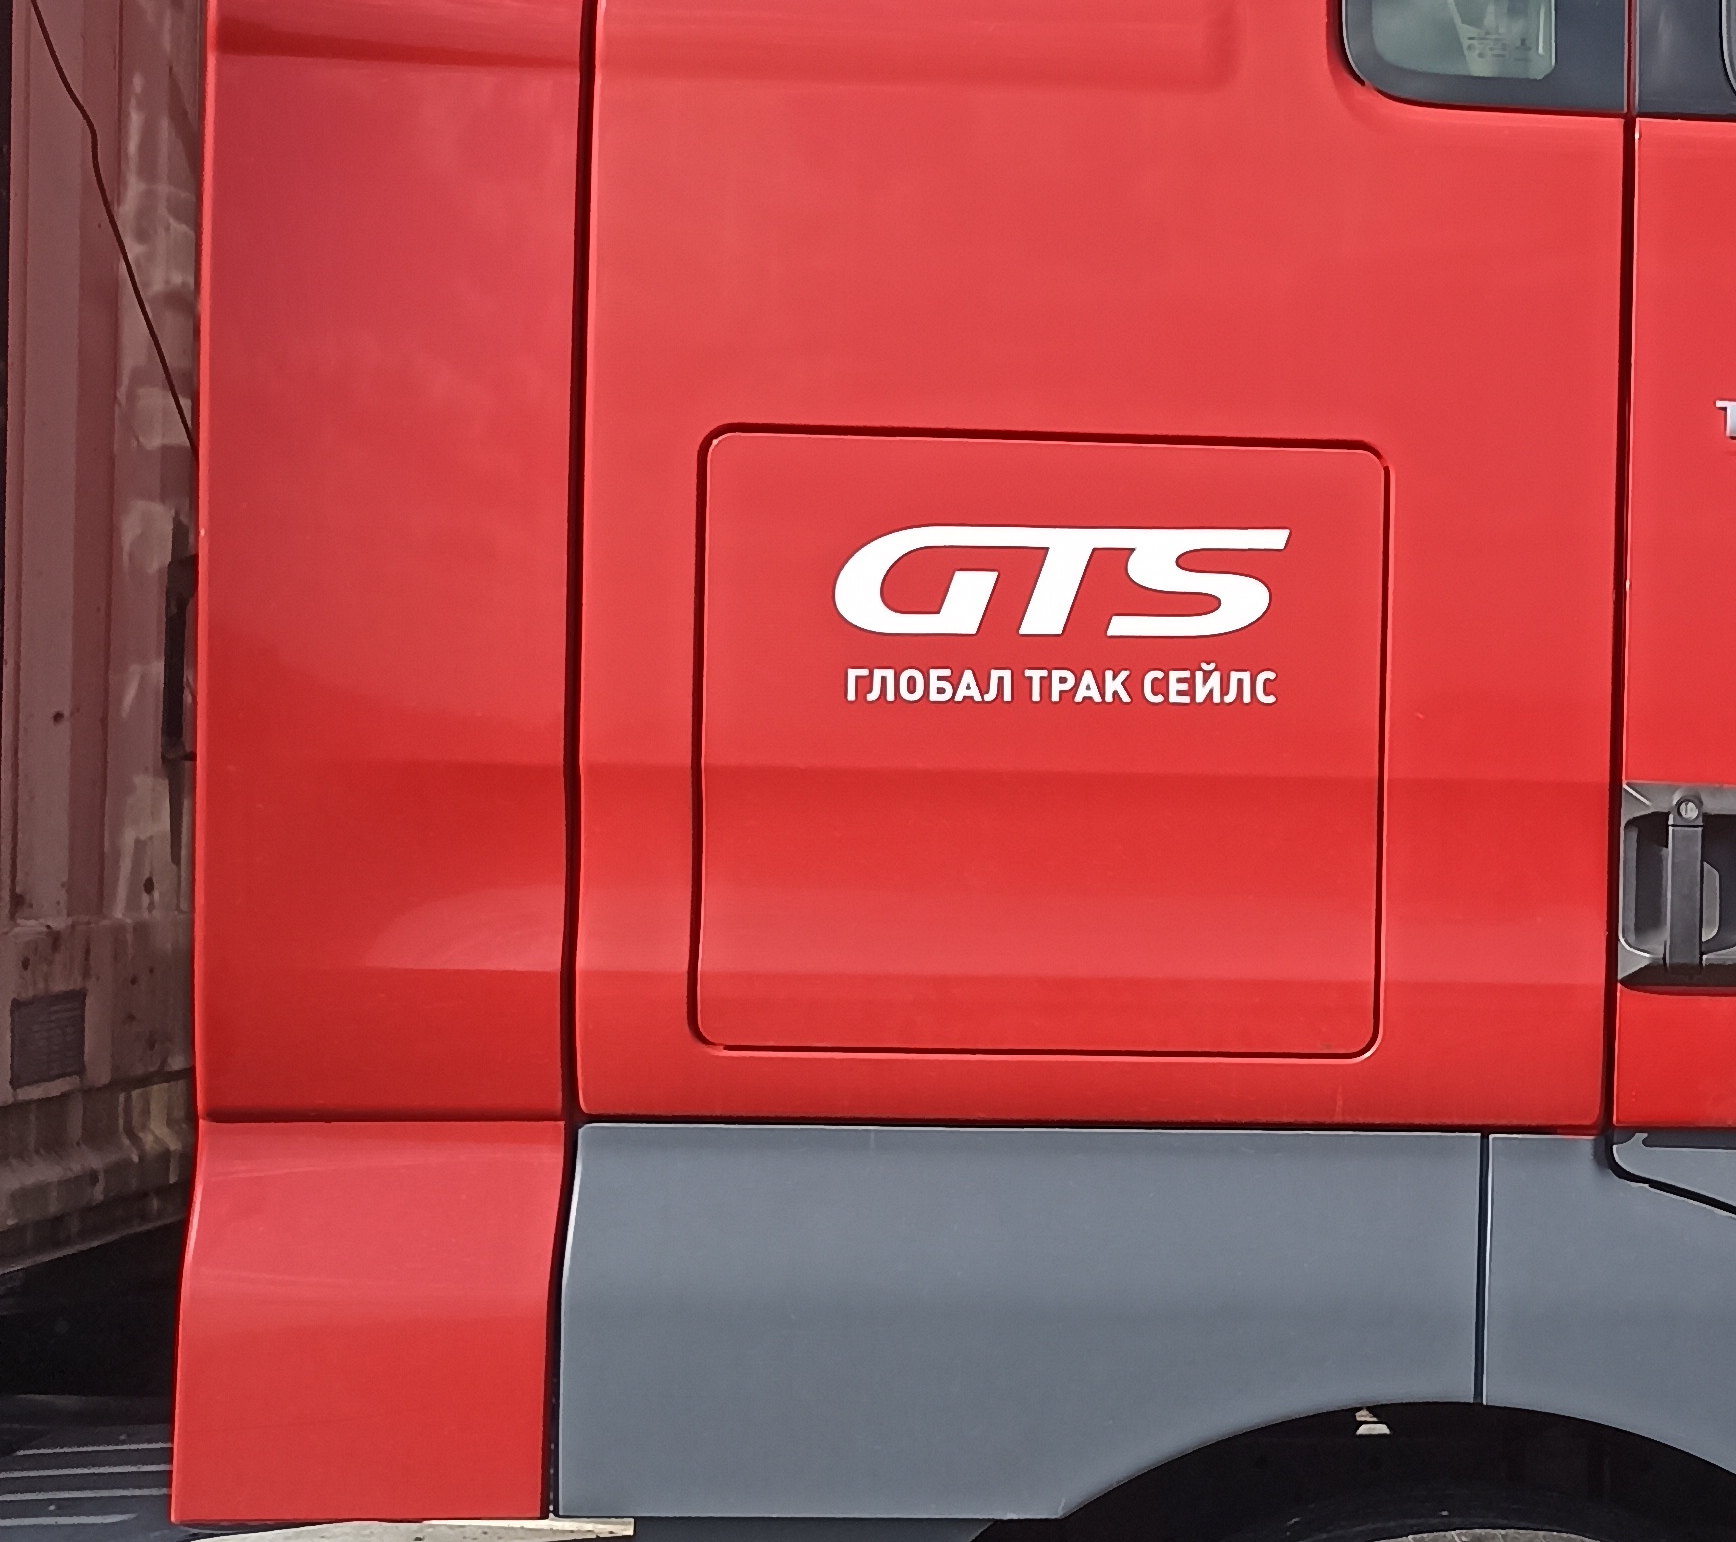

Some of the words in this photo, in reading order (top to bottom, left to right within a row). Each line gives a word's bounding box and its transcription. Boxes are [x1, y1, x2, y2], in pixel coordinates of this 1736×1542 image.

[834, 524, 1292, 637] GTS
[845, 667, 1013, 703] ГЛОБАЛ
[1023, 669, 1132, 704] ТРАК
[1142, 662, 1278, 705] СЕЙЛС
